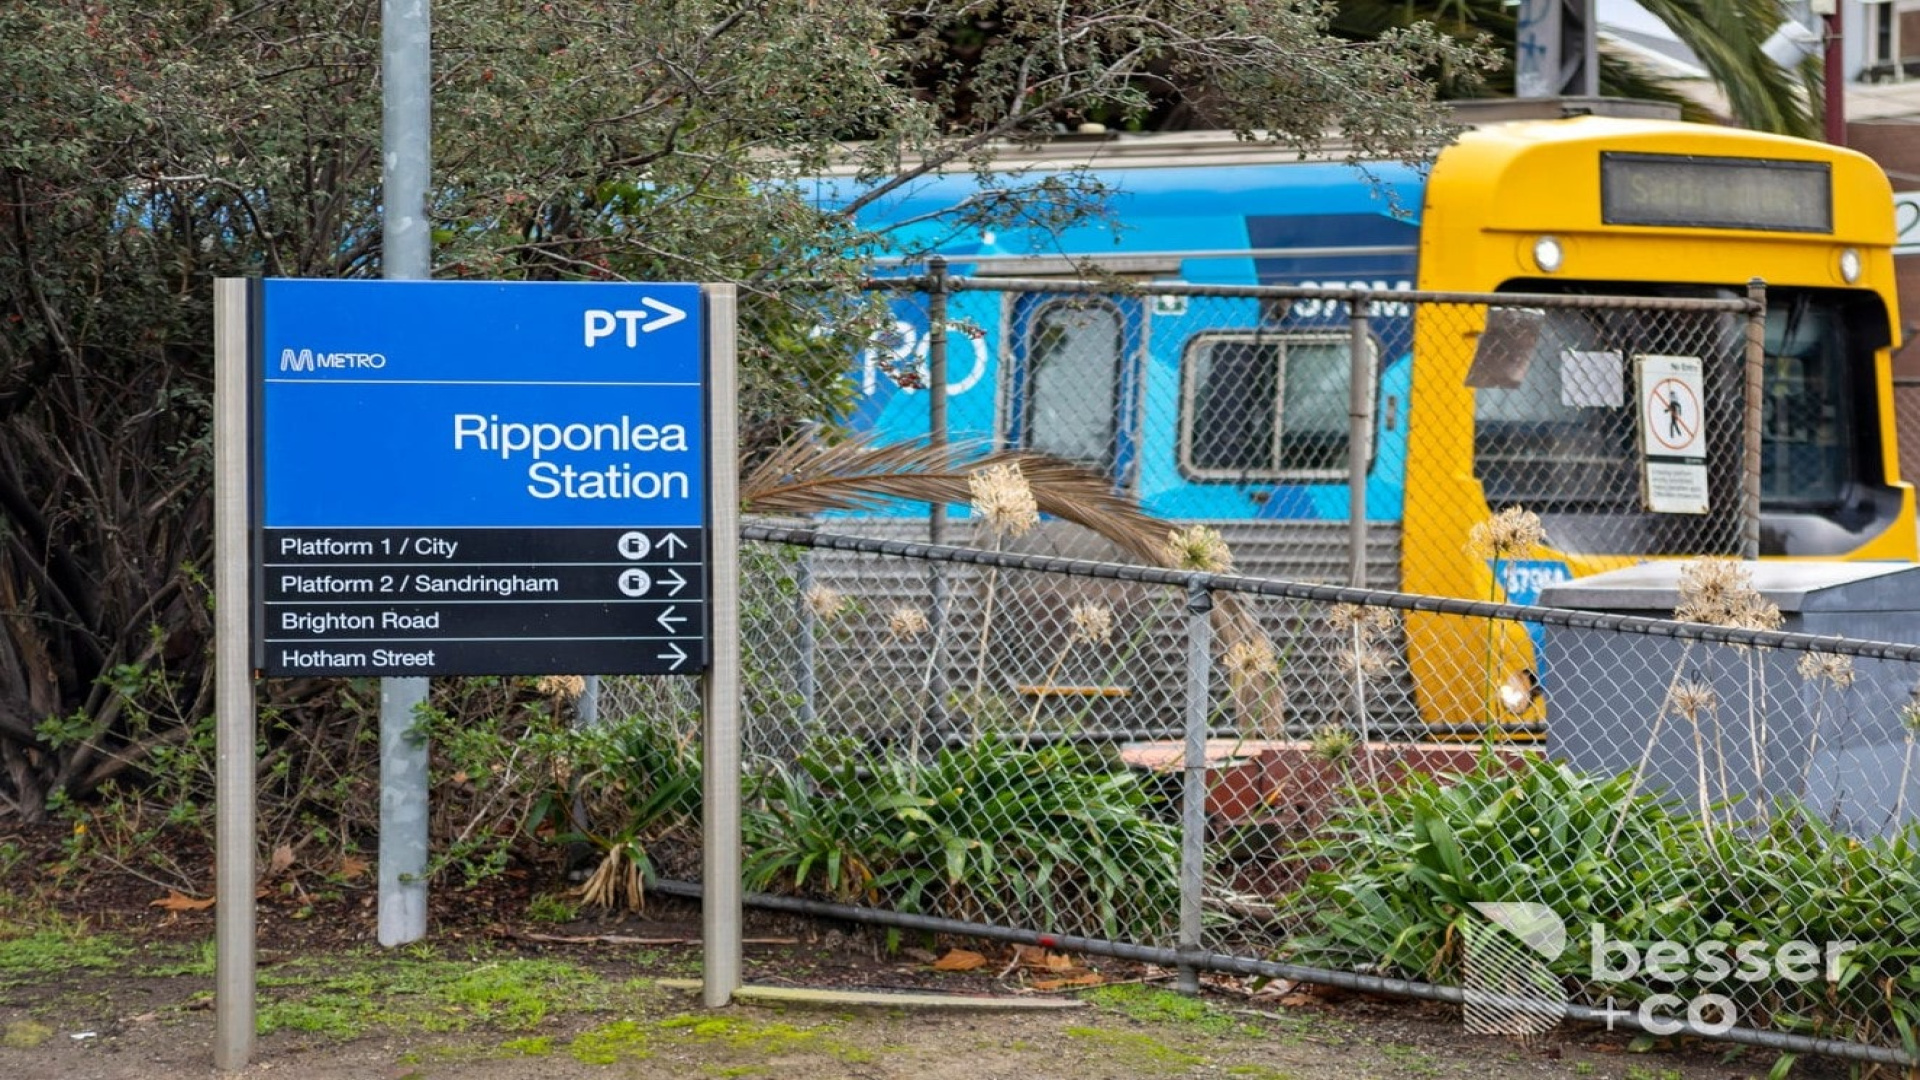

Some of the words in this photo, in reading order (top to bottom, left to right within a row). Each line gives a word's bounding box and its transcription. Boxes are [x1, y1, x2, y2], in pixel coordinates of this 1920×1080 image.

[316, 352, 386, 369] METRO
[454, 414, 688, 460] Ripponlea
[528, 461, 689, 499] Station
[280, 537, 373, 556] Platform
[380, 537, 390, 555] 1
[399, 537, 410, 555] /
[414, 537, 459, 559] City
[281, 575, 374, 593] Platform
[379, 575, 394, 593] 2
[399, 574, 410, 593] /
[415, 574, 559, 596] Sandringham
[281, 611, 375, 634] Brighton
[381, 611, 440, 629] Road
[282, 649, 366, 668] Hotham
[371, 648, 436, 668] Street
